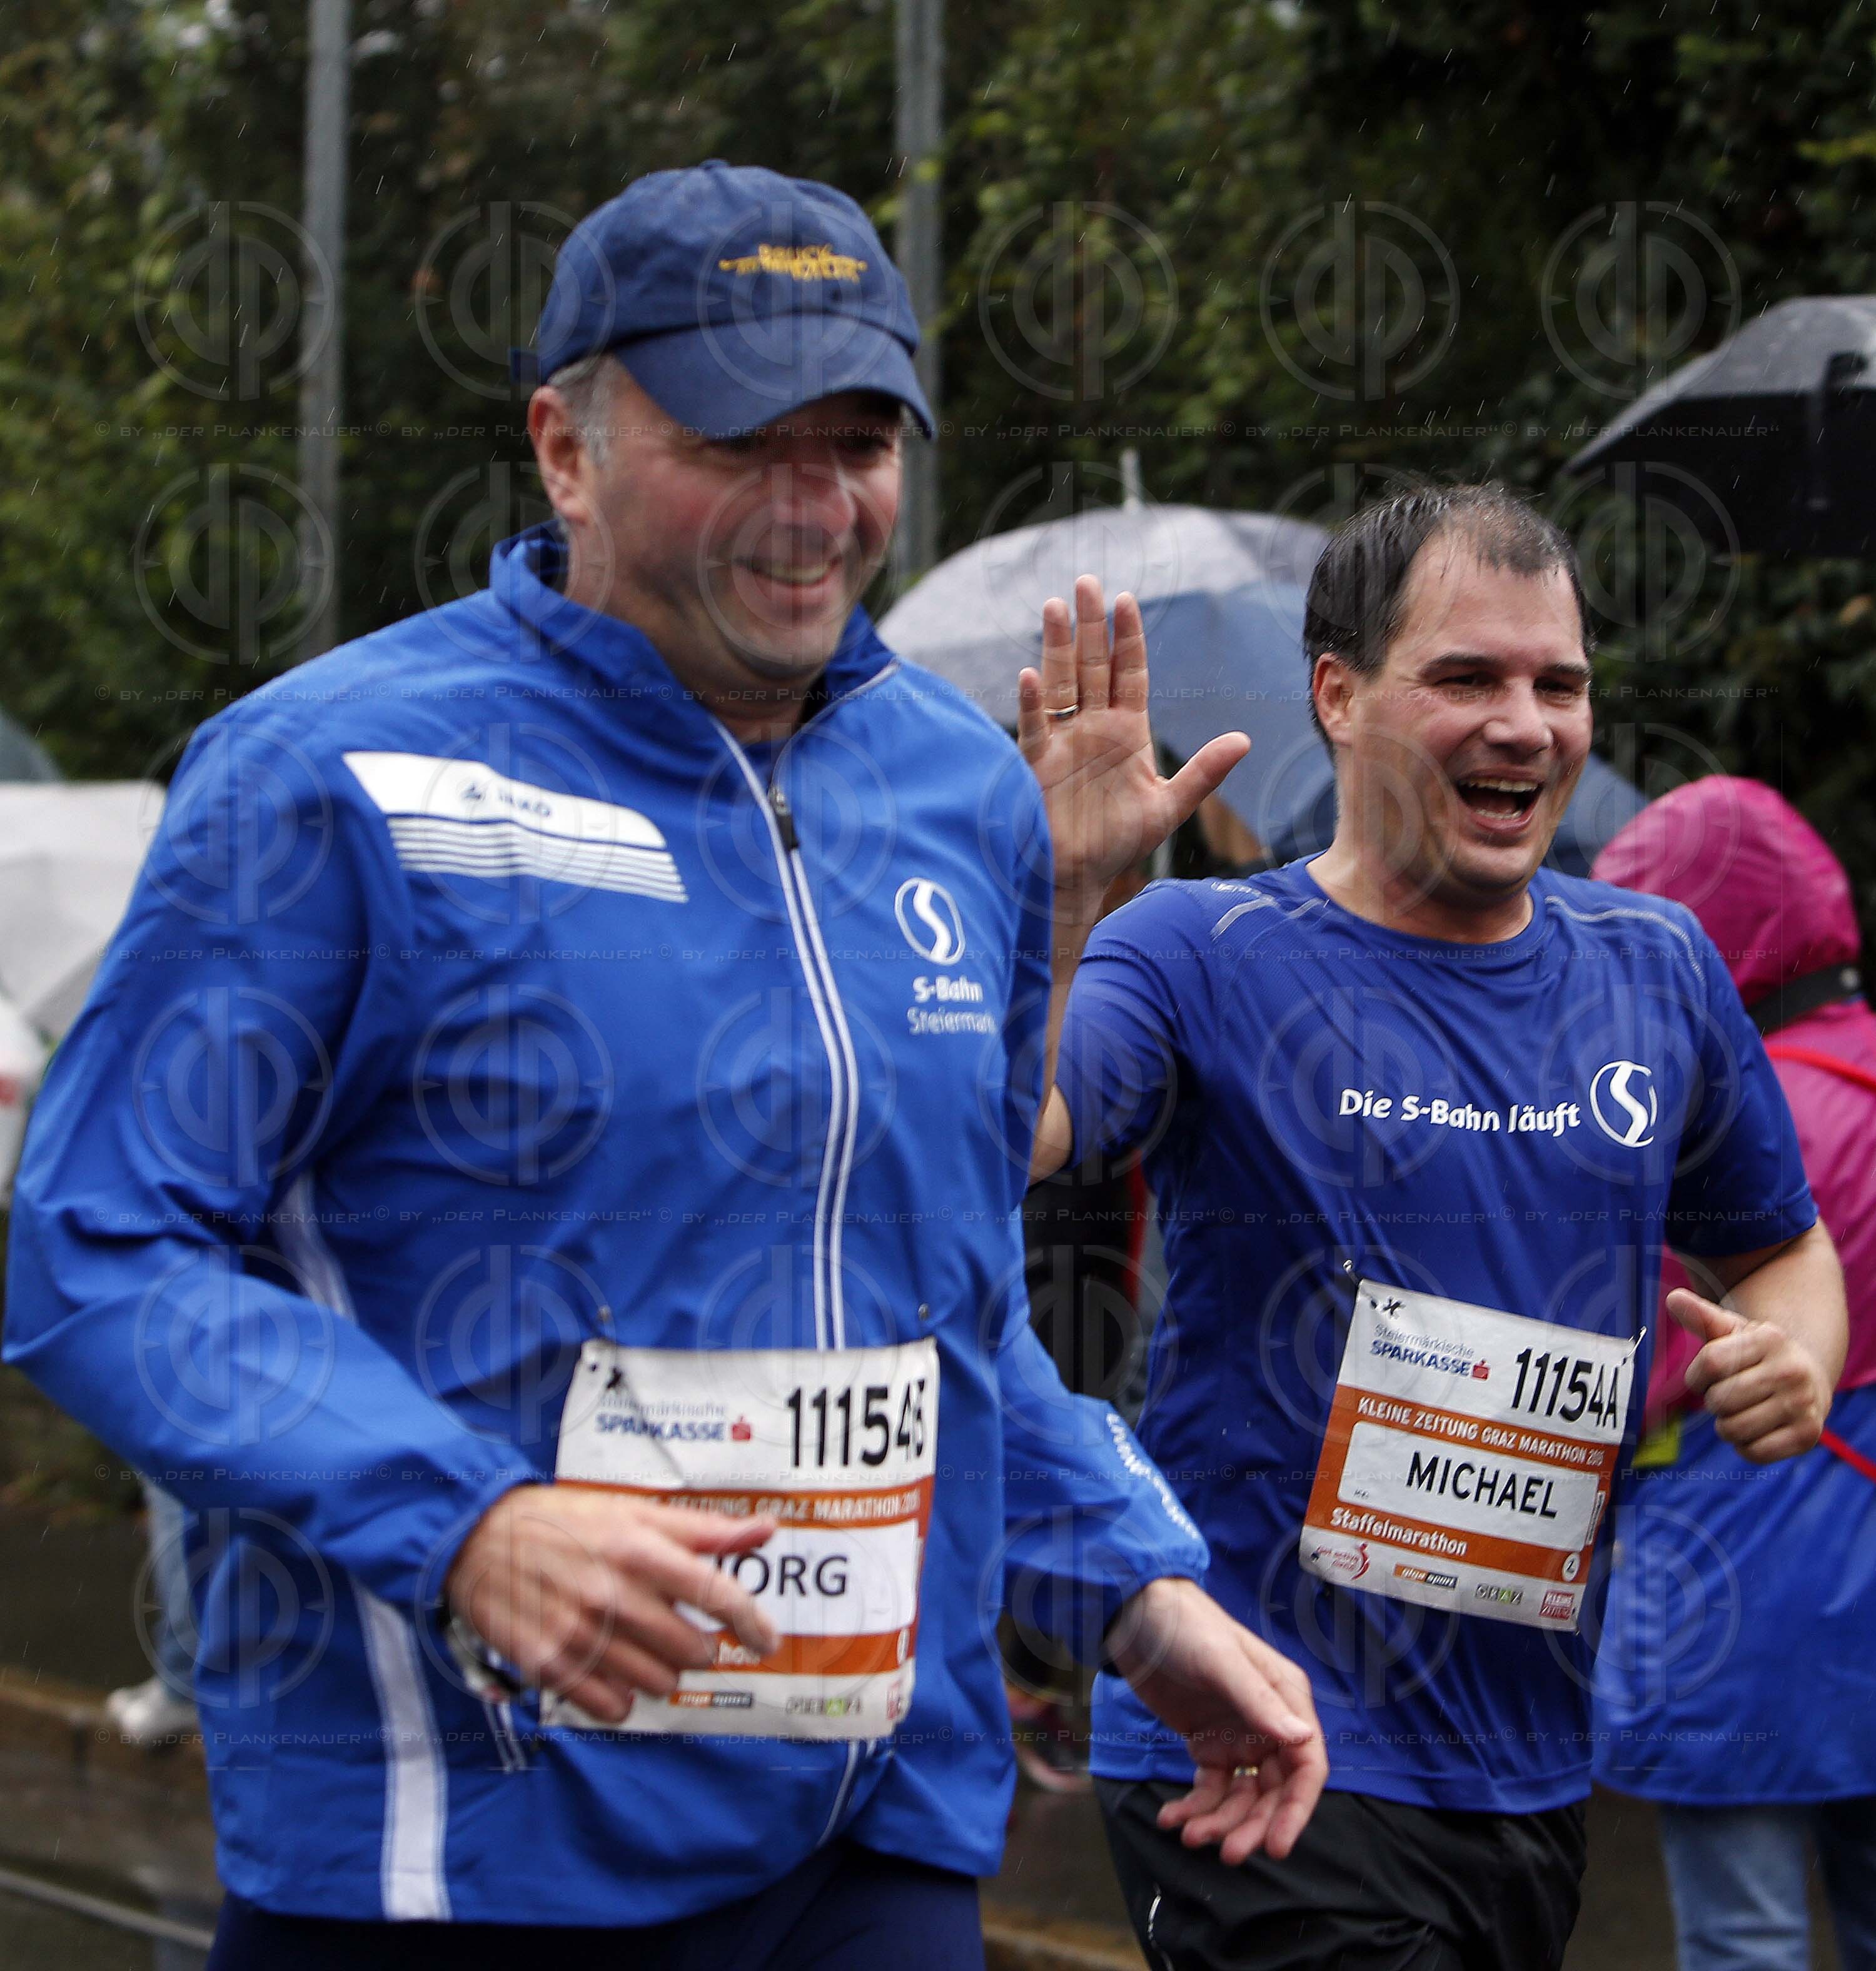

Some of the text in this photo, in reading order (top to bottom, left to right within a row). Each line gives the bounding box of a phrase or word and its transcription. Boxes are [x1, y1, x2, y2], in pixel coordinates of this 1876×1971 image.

[912, 975, 984, 1003] S-Bahn
[1339, 1087, 1581, 1137] Die S-Bahn läuft
[1369, 1339, 1472, 1376] SPARKASSE
[1511, 1348, 1618, 1429] 11154A
[1357, 1396, 1413, 1425] KLEINE
[1413, 1411, 1480, 1441] ZEITUNG
[1481, 1426, 1518, 1449] GRAZ
[1518, 1435, 1588, 1464] MARATHON
[1406, 1451, 1558, 1518] MICHAEL
[1329, 1506, 1468, 1556] Staffelmarathon
